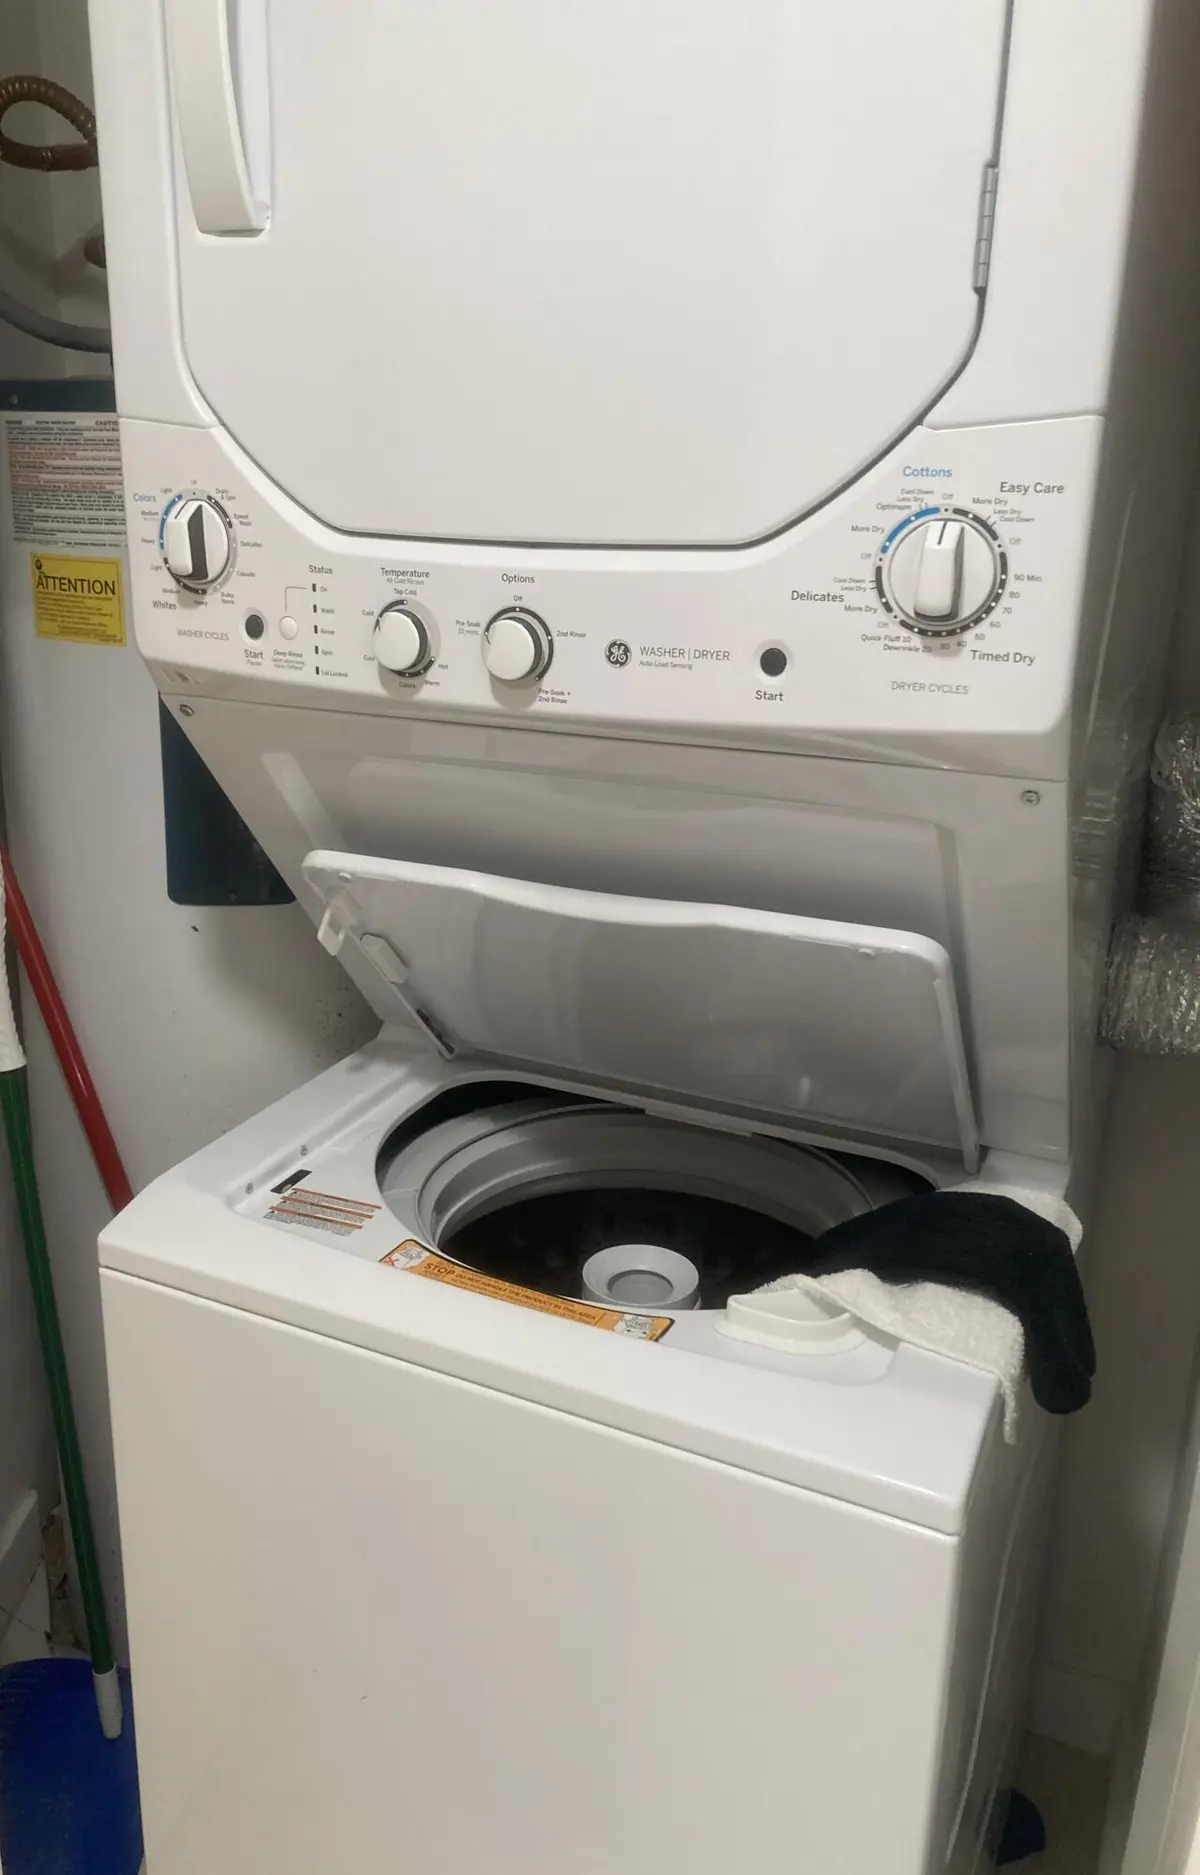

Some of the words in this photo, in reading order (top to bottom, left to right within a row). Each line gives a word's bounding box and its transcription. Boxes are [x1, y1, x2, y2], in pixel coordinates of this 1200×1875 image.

[903, 466, 952, 478] Cottons
[1000, 481, 1030, 496] Easy
[1034, 482, 1064, 493] Care
[133, 493, 156, 502] Colors
[994, 498, 1008, 506] Dry
[876, 503, 912, 511] Optimum
[872, 526, 885, 534] Dry
[308, 565, 333, 575] Status
[380, 567, 430, 578] Temperature
[501, 573, 535, 584] Options
[1013, 573, 1025, 581] 90
[36, 574, 116, 595] ATTENTION
[791, 590, 844, 602] Delicates
[152, 600, 177, 610] Whites
[865, 605, 878, 613] Dry
[178, 629, 203, 638] WASHER
[204, 631, 230, 640] CYCLES
[861, 634, 881, 642] Quick
[273, 649, 287, 657] Deep
[640, 646, 685, 659] WASHER
[693, 649, 730, 660] DRYER
[884, 644, 920, 652] Dewrinkle
[244, 649, 263, 659] Start
[970, 649, 1010, 662] Timed
[1014, 652, 1036, 666] Dry
[670, 662, 693, 671] Sensing
[891, 681, 926, 691] DRYER
[929, 683, 969, 694] CYCLES
[755, 690, 784, 701] Start
[424, 1262, 456, 1277] STOP
